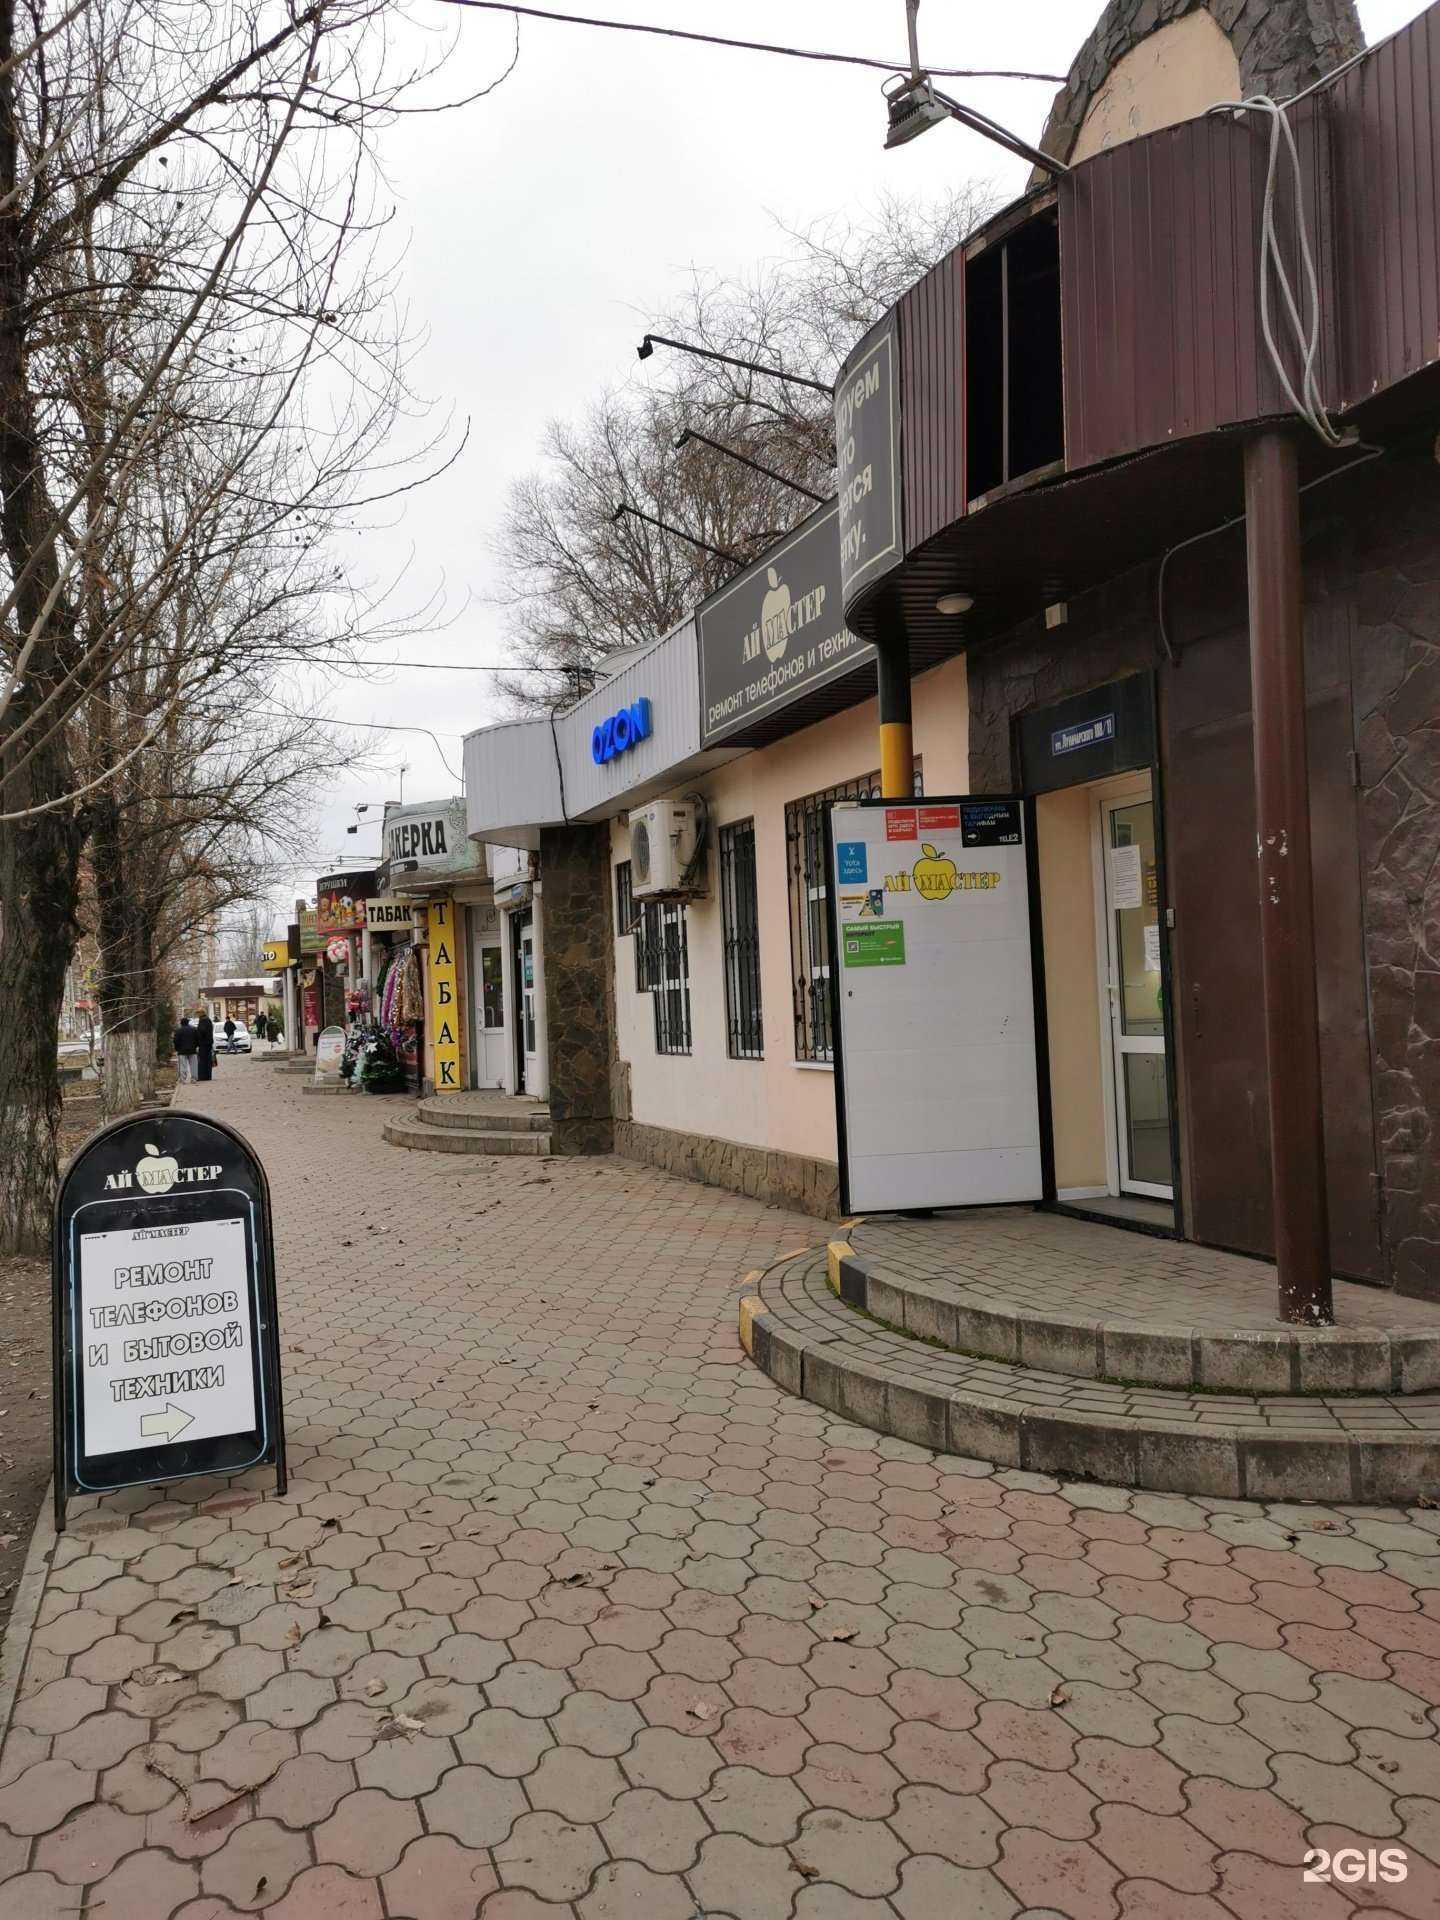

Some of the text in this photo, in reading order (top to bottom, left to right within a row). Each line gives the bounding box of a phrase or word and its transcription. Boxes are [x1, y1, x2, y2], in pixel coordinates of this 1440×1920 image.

[742, 584, 826, 664] АЙ МАСТЕР
[708, 689, 743, 729] ремонт
[744, 655, 805, 703] телефонов
[807, 650, 816, 669] и
[592, 696, 652, 765] OZON
[883, 870, 1001, 892] АЙ МАСТЕР
[368, 904, 412, 923] ТАБАК
[433, 902, 456, 1084] ТАБАК
[103, 1165, 223, 1190] АЙ МАСТЕР
[114, 1258, 213, 1289] РЕМОНТ
[90, 1290, 239, 1329] ТЕЛЕФОНОВ
[88, 1321, 243, 1367] И БЫТОВОЙ
[110, 1365, 225, 1402] ТЕХНИКИ
